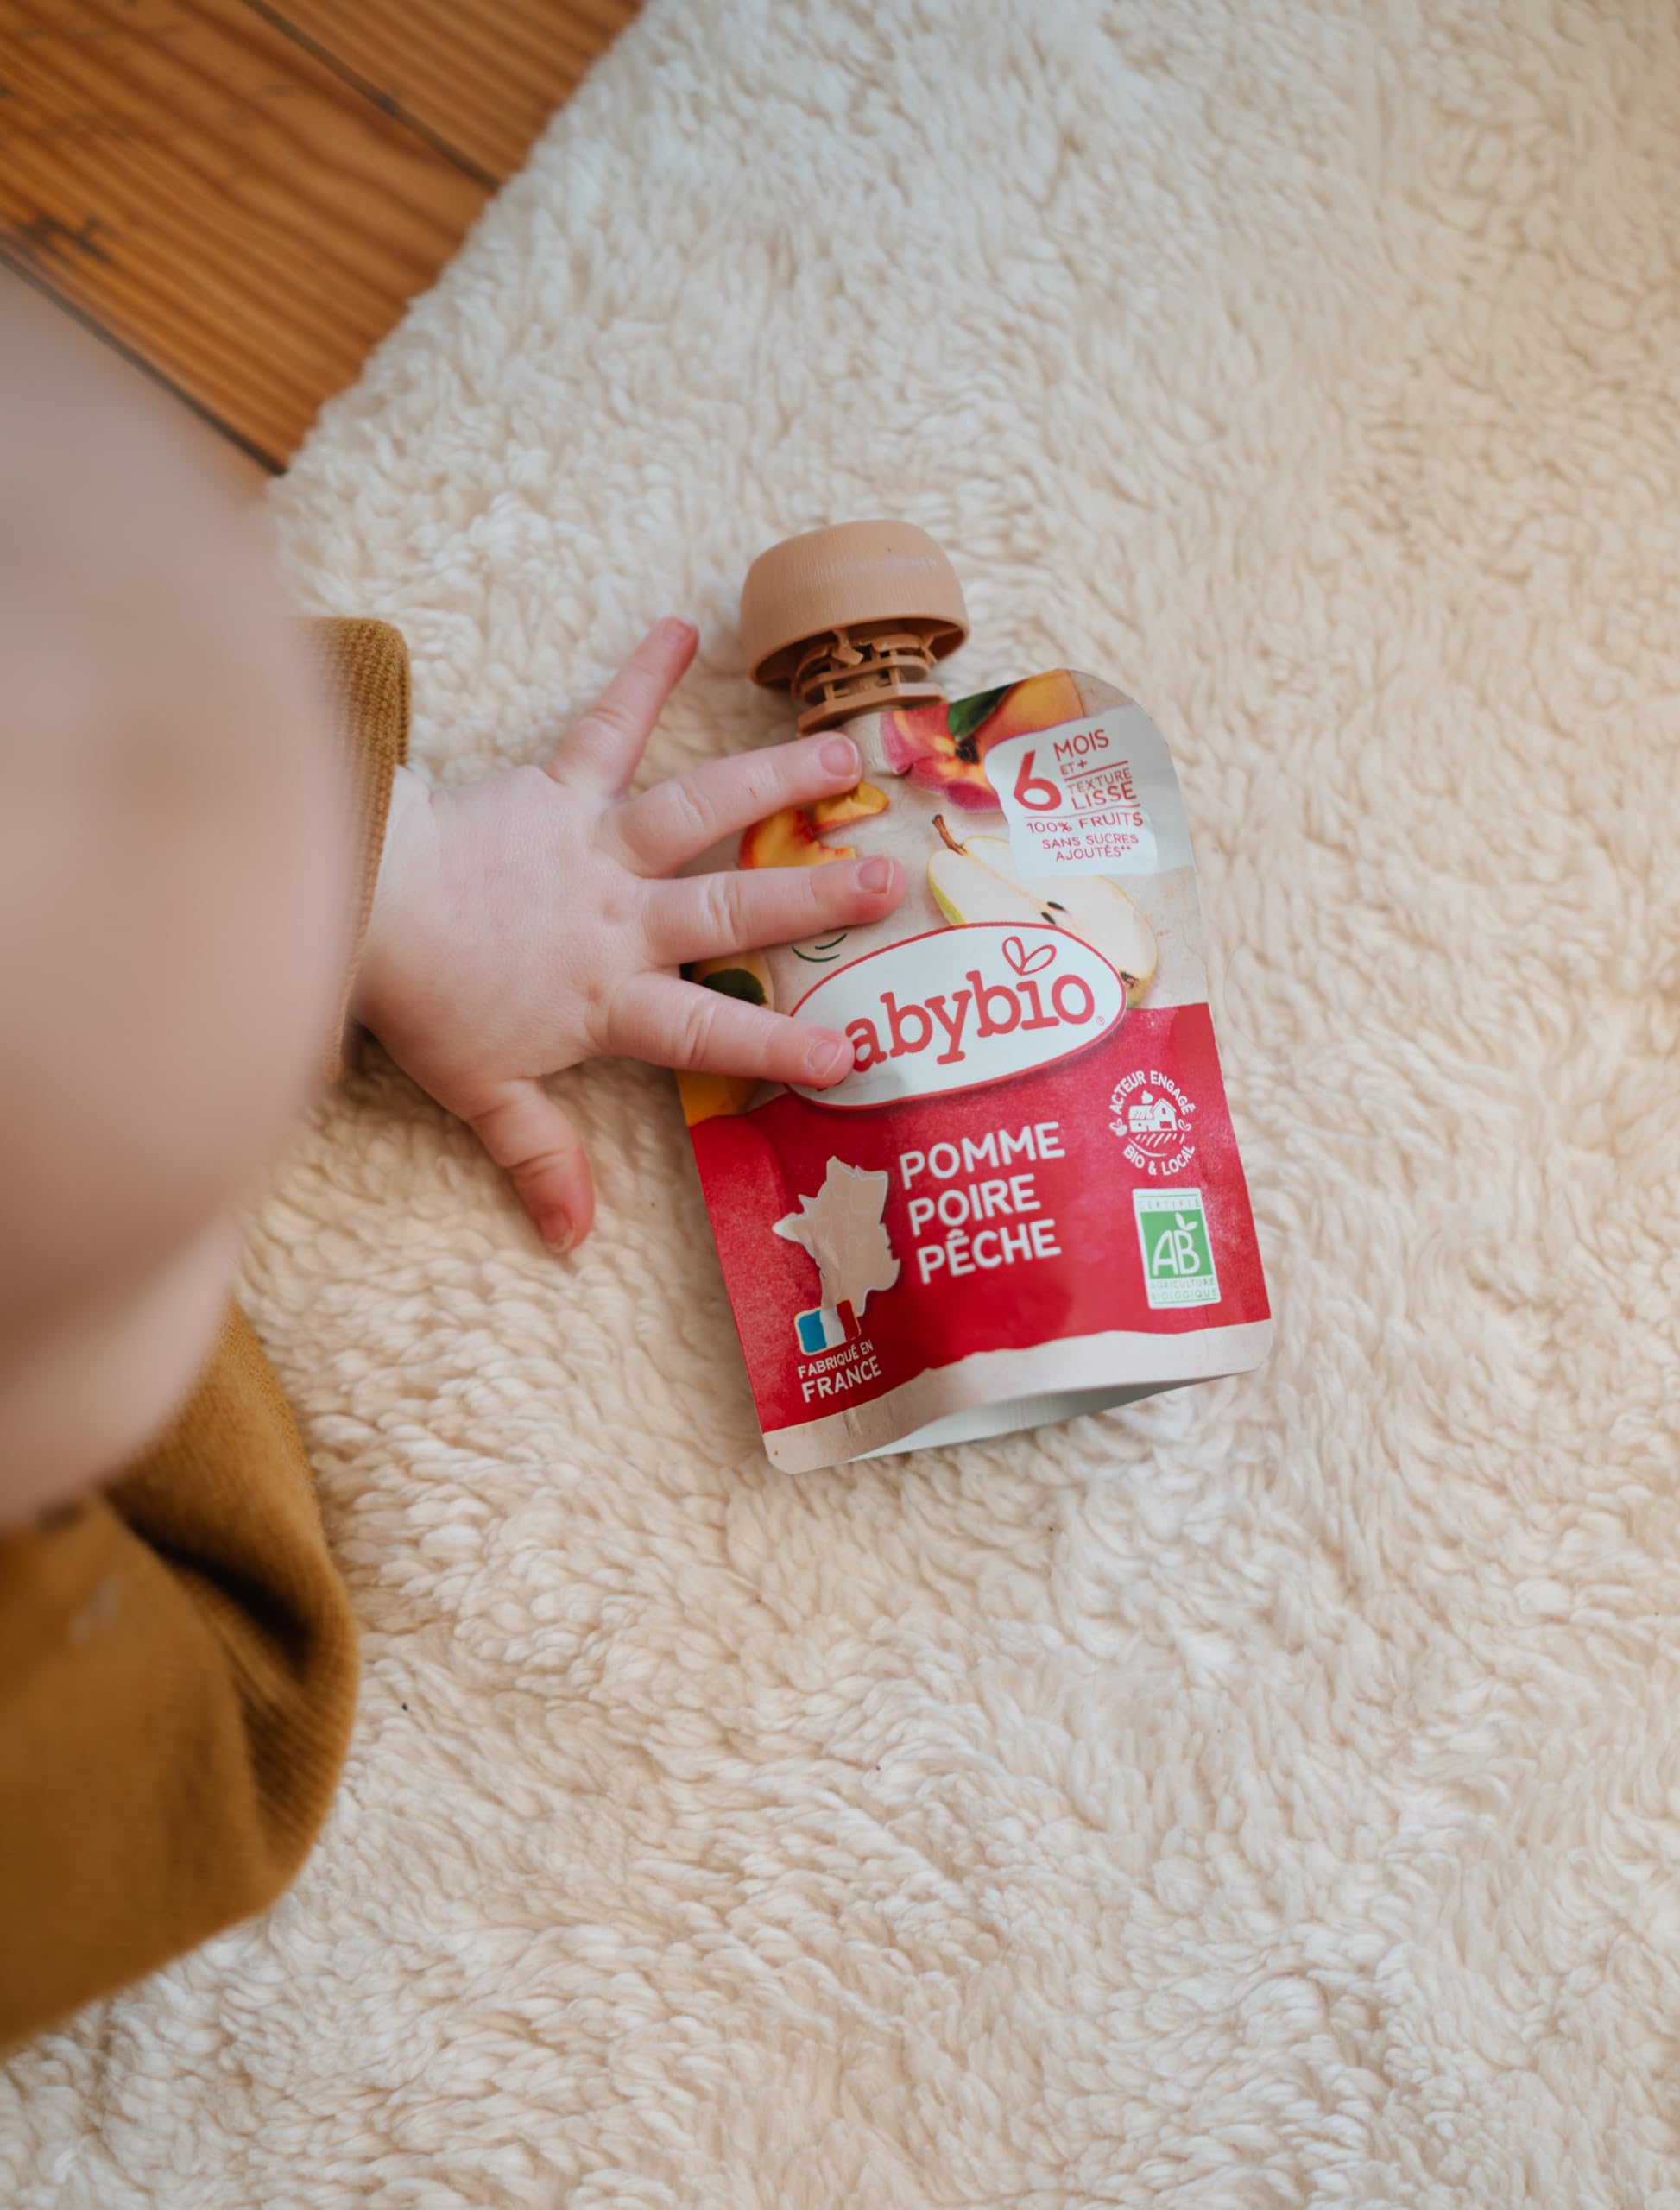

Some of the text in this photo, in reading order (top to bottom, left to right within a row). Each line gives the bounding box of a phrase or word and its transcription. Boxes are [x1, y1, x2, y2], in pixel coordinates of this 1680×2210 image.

[1053, 729, 1109, 762] MOIS
[1014, 749, 1062, 811] 6
[1060, 761, 1075, 776] ET
[1066, 767, 1133, 795] TEXTURE
[1071, 780, 1138, 810] LISSE
[1026, 811, 1144, 833] 100% FRUITS
[1042, 832, 1140, 850] SANS SUCRES
[844, 969, 1096, 1073] abybio
[1108, 1070, 1147, 1115] ACTEUR
[899, 1121, 1066, 1190] POMME
[1123, 1144, 1196, 1176] BIO & LOCAL
[908, 1173, 1042, 1237] POIRE
[916, 1218, 1062, 1285] PÊCHE
[1152, 1229, 1201, 1276] AB
[797, 1339, 874, 1380] FABRIQUÉ EN
[801, 1354, 881, 1403] FRANCE
